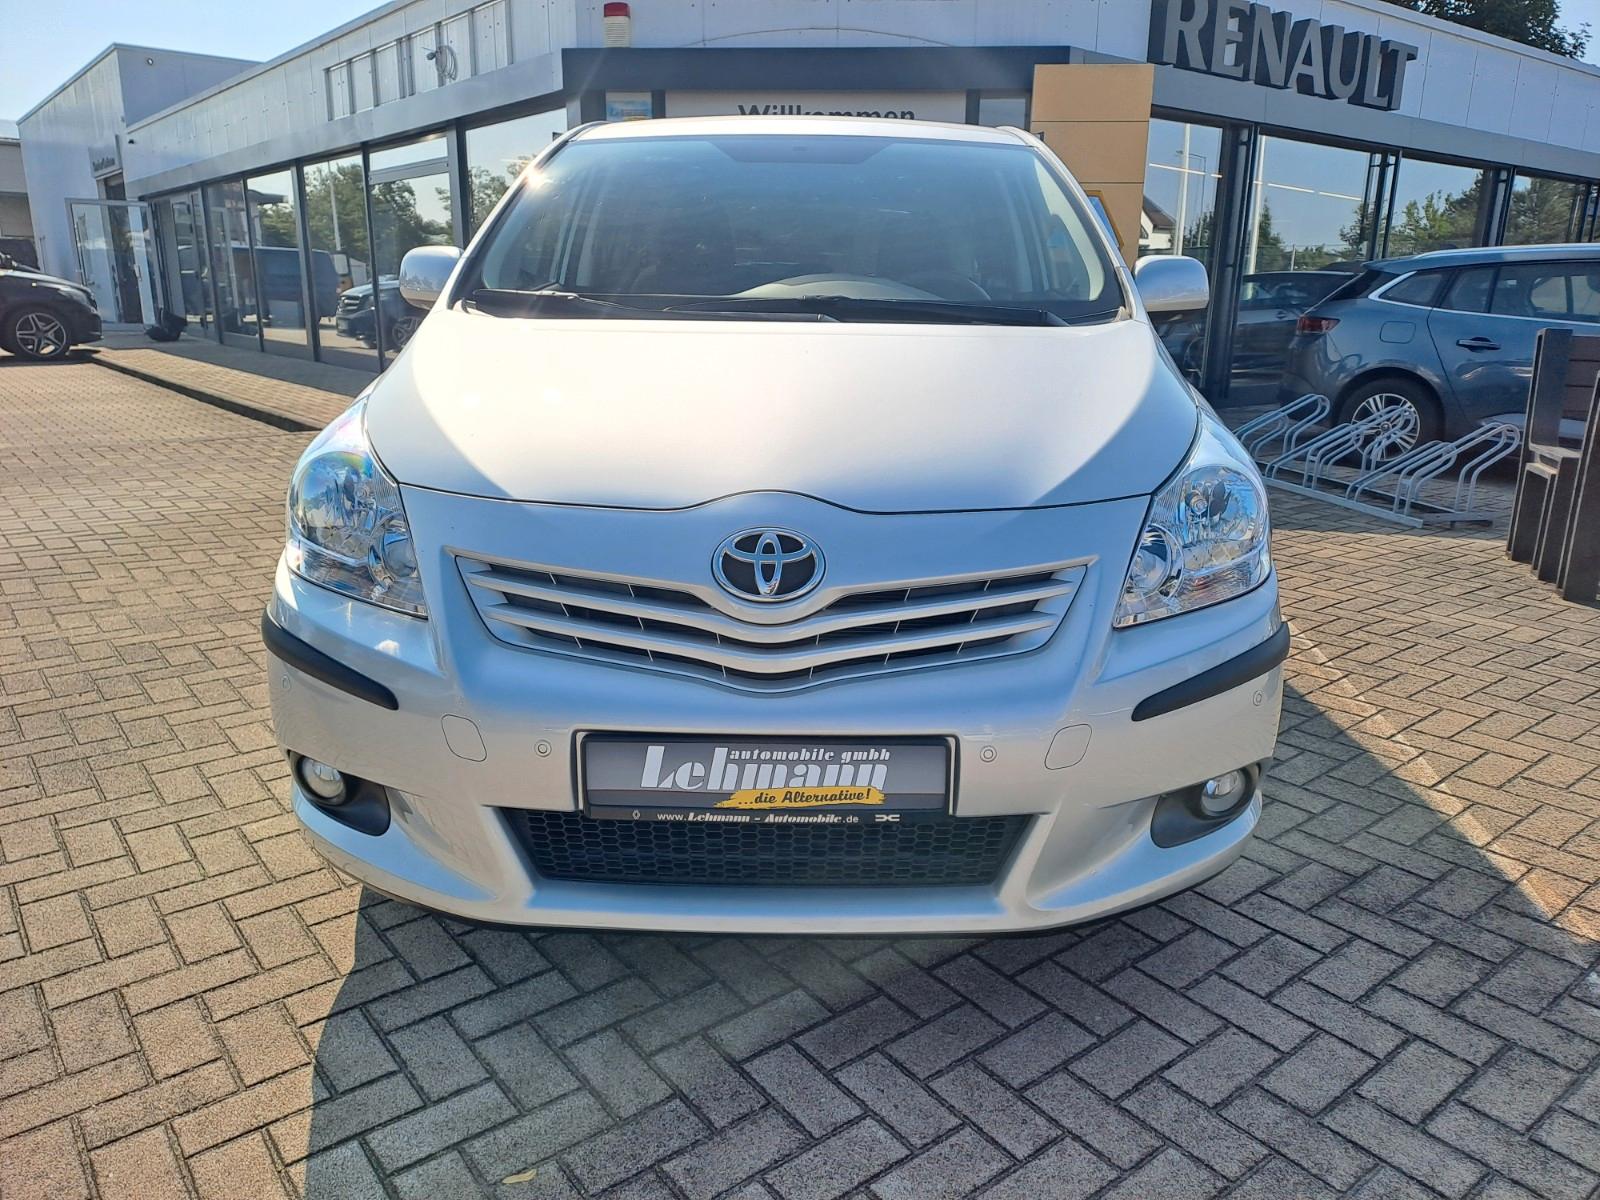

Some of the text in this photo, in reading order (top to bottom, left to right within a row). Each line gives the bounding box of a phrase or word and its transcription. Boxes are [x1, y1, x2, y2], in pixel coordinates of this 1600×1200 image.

[1148, 0, 1419, 111] RENAULT
[738, 104, 915, 119] Willken
[729, 748, 890, 763] automobile gmbh
[640, 745, 888, 791] Lehmann
[781, 788, 871, 803] Alternative!
